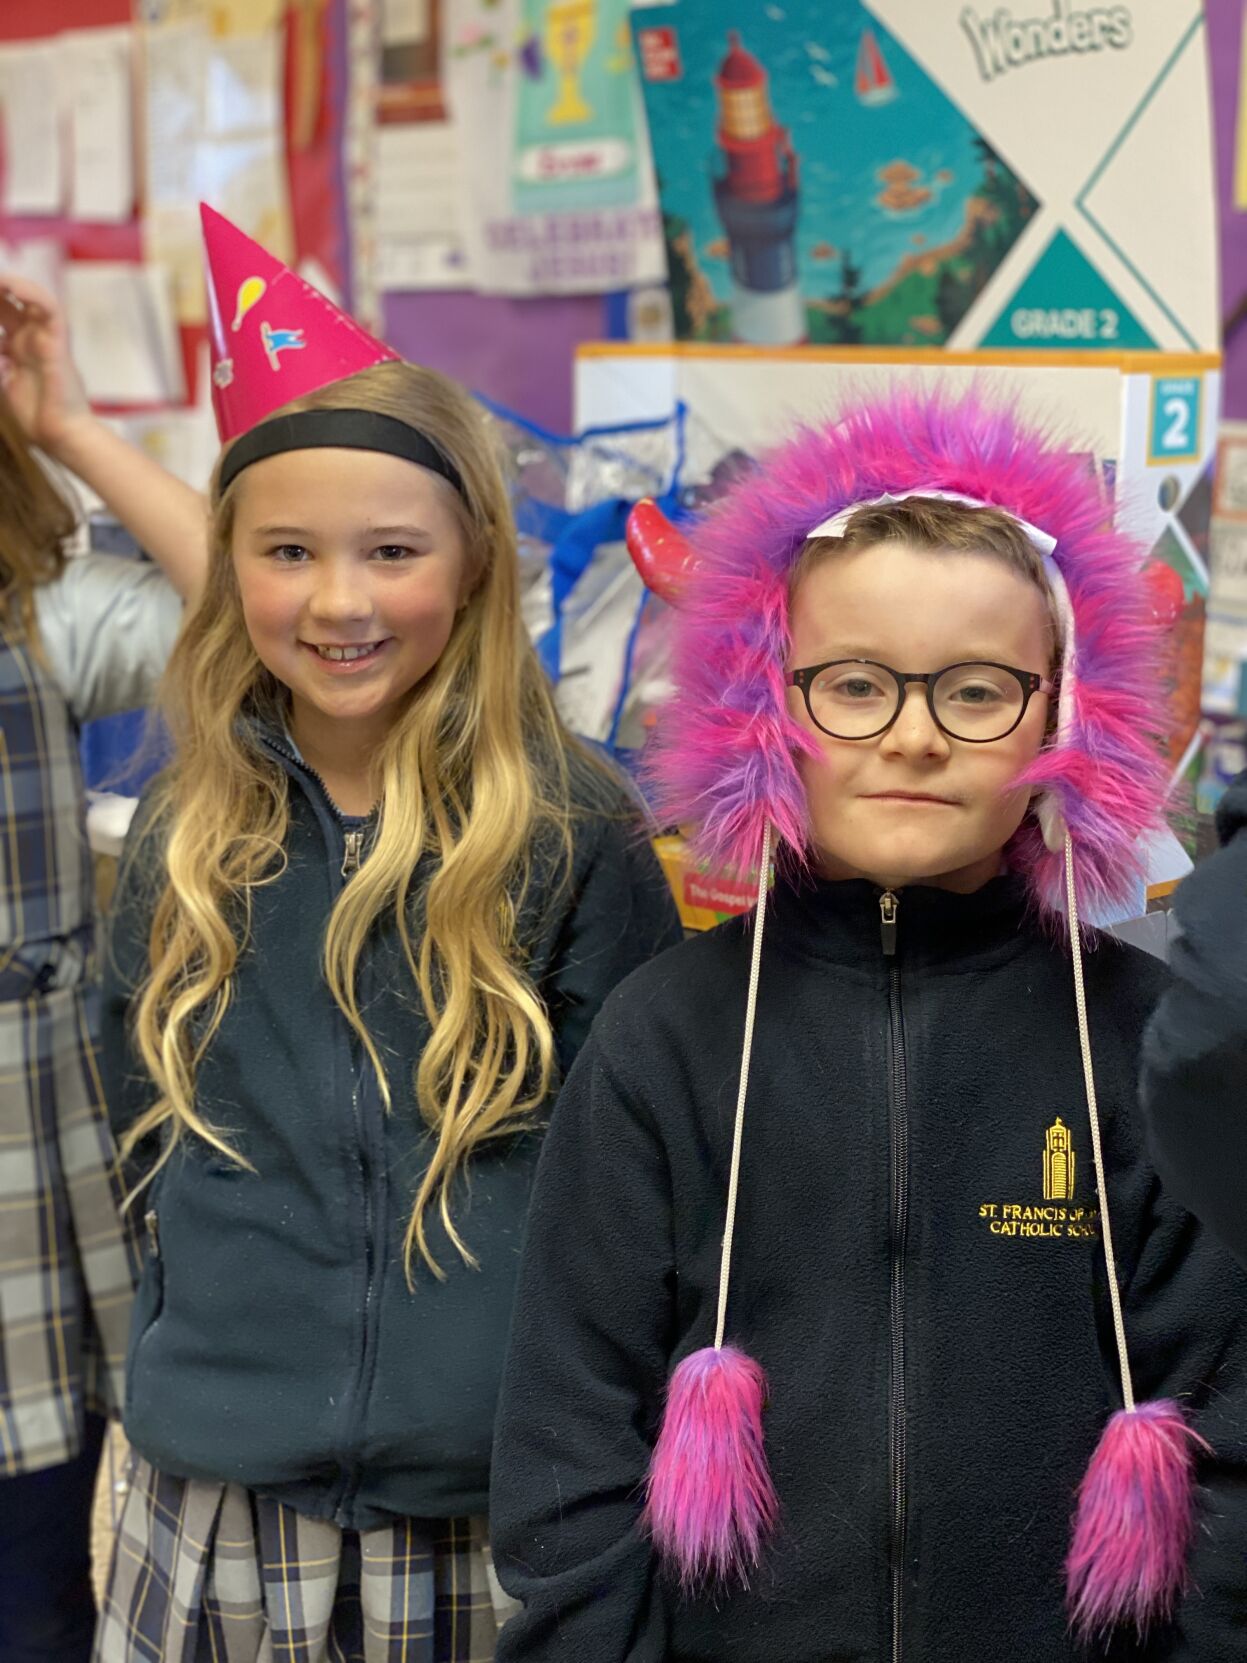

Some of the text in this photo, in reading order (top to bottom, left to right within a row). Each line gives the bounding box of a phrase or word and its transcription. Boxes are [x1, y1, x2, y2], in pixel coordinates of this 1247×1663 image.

[959, 0, 1133, 83] Wonders
[1010, 307, 1120, 340] GRADE 2
[1161, 396, 1191, 449] 2
[978, 1203, 998, 1218] ST.
[1002, 1204, 1067, 1221] FRANCIS
[989, 1221, 1063, 1237] CATHOLIC
